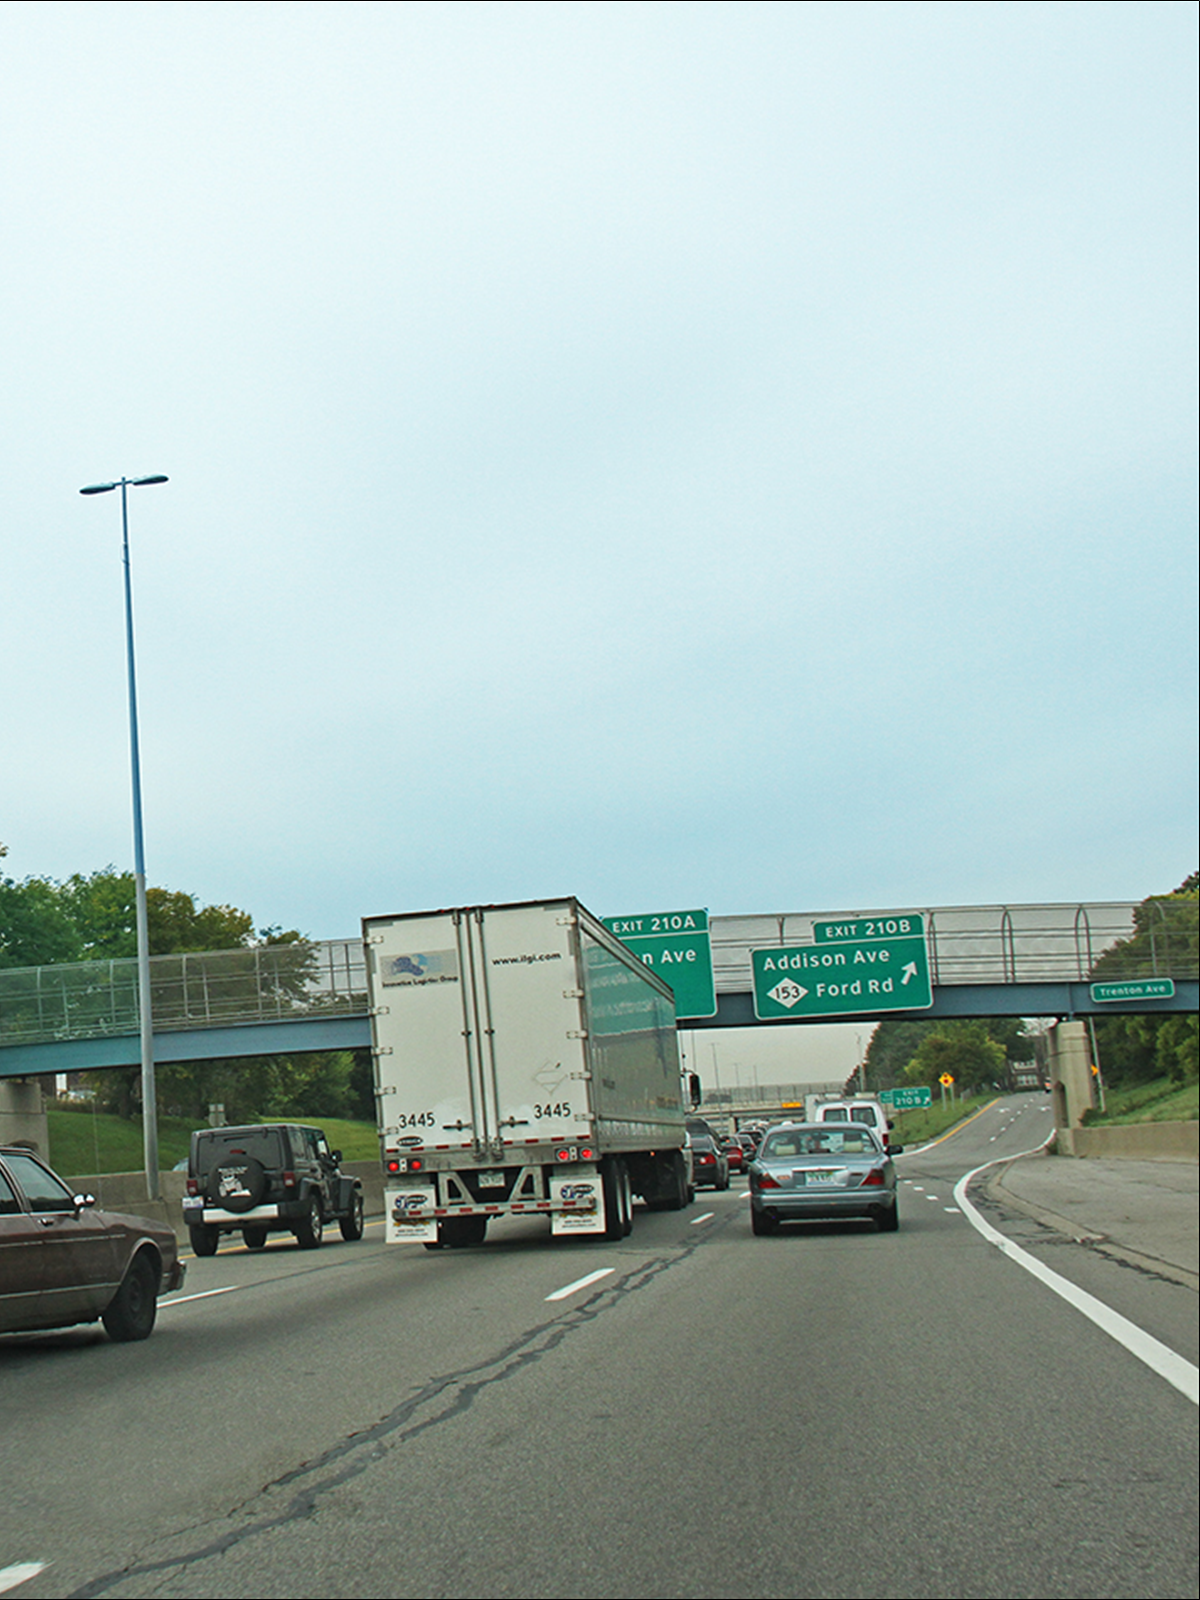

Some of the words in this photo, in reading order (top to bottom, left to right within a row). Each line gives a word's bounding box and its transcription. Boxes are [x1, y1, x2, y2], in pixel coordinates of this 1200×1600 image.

[612, 920, 643, 933] EXIT
[651, 915, 696, 931] 210A
[825, 925, 857, 938] EXIT
[865, 919, 911, 935] 210B
[492, 952, 561, 966] www.ilgi.com
[661, 949, 696, 964] Ave
[763, 952, 846, 971] Addison
[853, 949, 890, 964] Ave
[774, 986, 800, 1000] 153
[816, 980, 862, 997] Ford
[868, 978, 893, 993] Rd
[1100, 987, 1143, 997] Trenton
[1145, 985, 1166, 993] Ave
[534, 1102, 571, 1119] 3445
[399, 1112, 436, 1129] 3445
